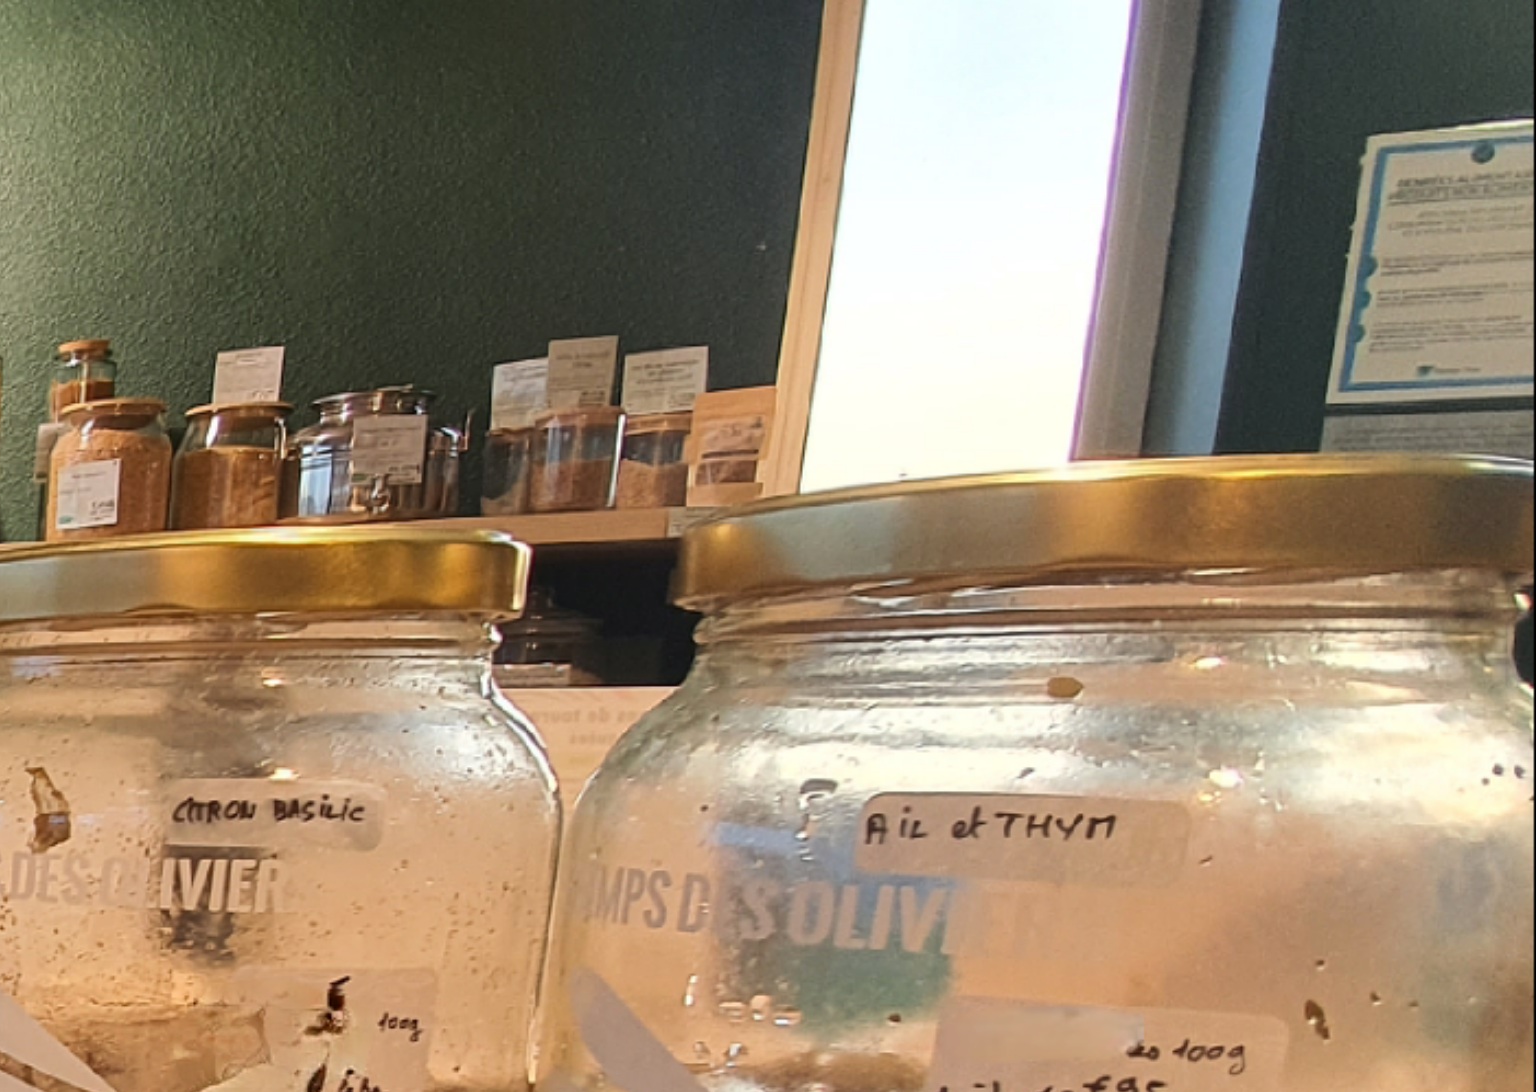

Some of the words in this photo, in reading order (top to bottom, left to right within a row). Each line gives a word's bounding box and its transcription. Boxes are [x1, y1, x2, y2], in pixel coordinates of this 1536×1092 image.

[172, 796, 257, 823] CITRON
[951, 806, 986, 839] et
[994, 812, 1117, 841] THYM
[9, 848, 90, 904] DES
[378, 1011, 423, 1043] 100g
[1172, 1038, 1246, 1076] 100g
